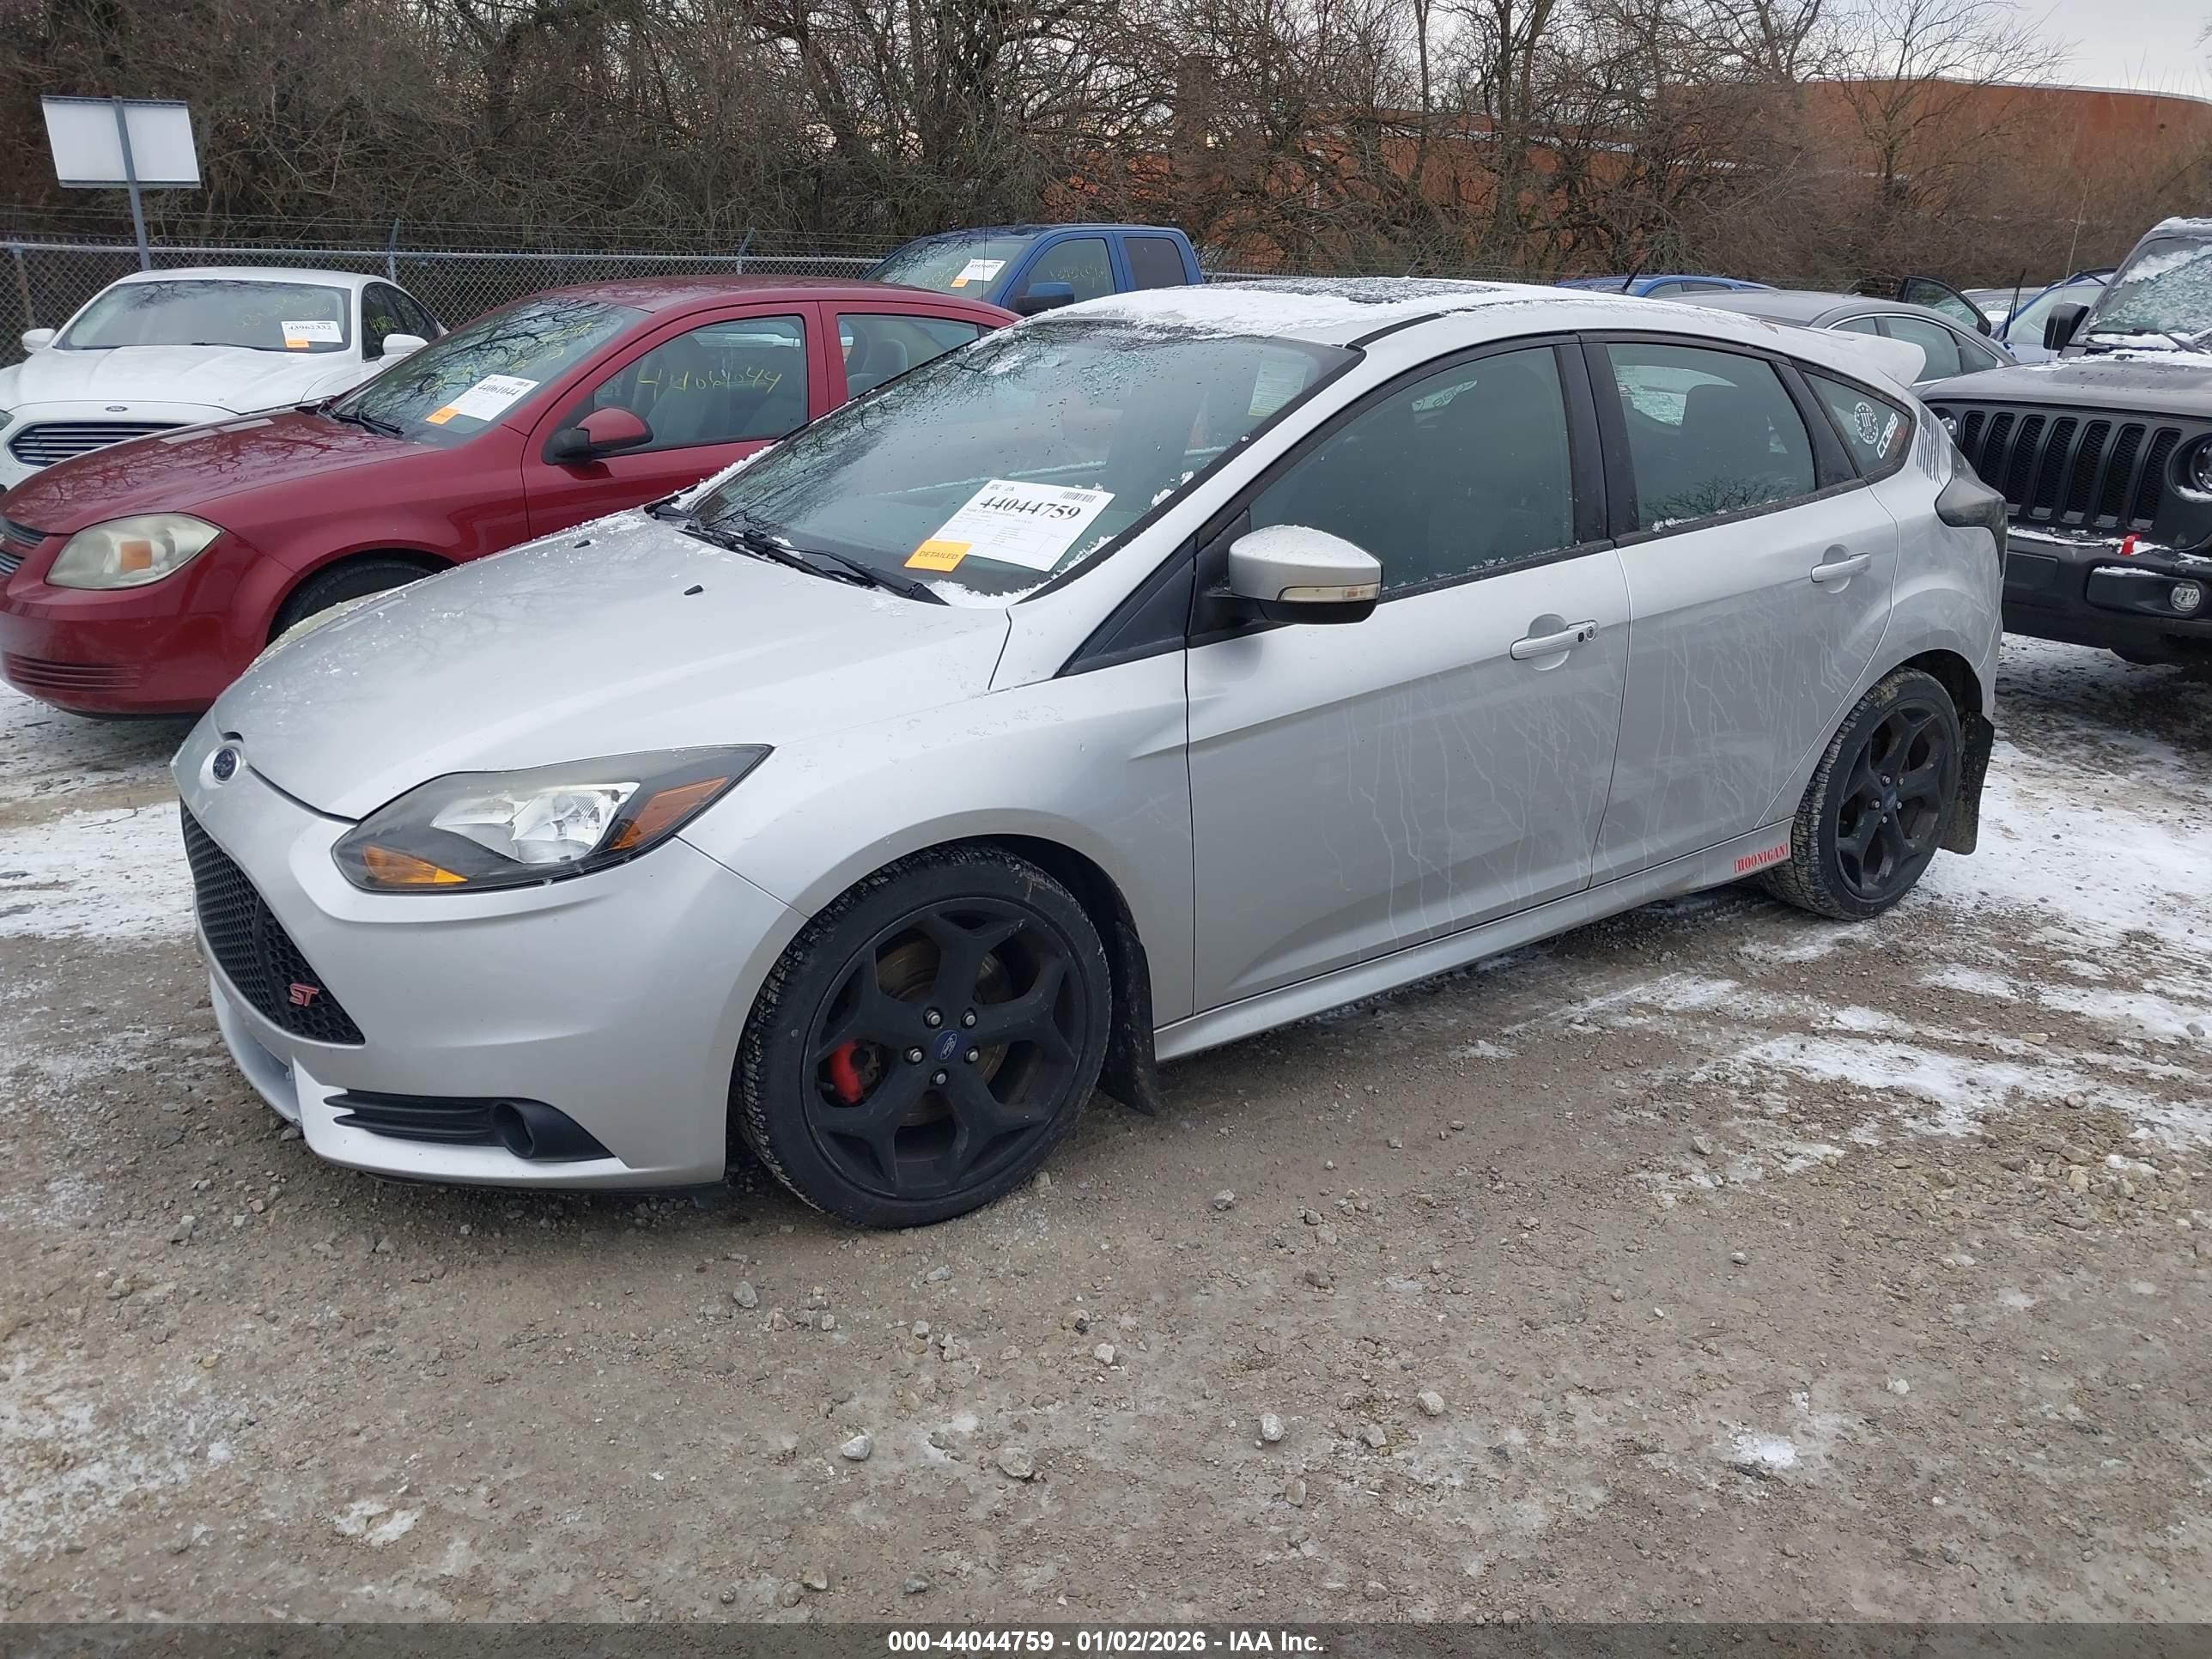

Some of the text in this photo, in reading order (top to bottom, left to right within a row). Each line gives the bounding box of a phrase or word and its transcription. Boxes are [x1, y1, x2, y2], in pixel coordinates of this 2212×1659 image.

[1876, 411, 1899, 459] COBB
[979, 495, 1081, 520] 44044759
[918, 550, 959, 560] DETAILED
[289, 982, 320, 1007] ST
